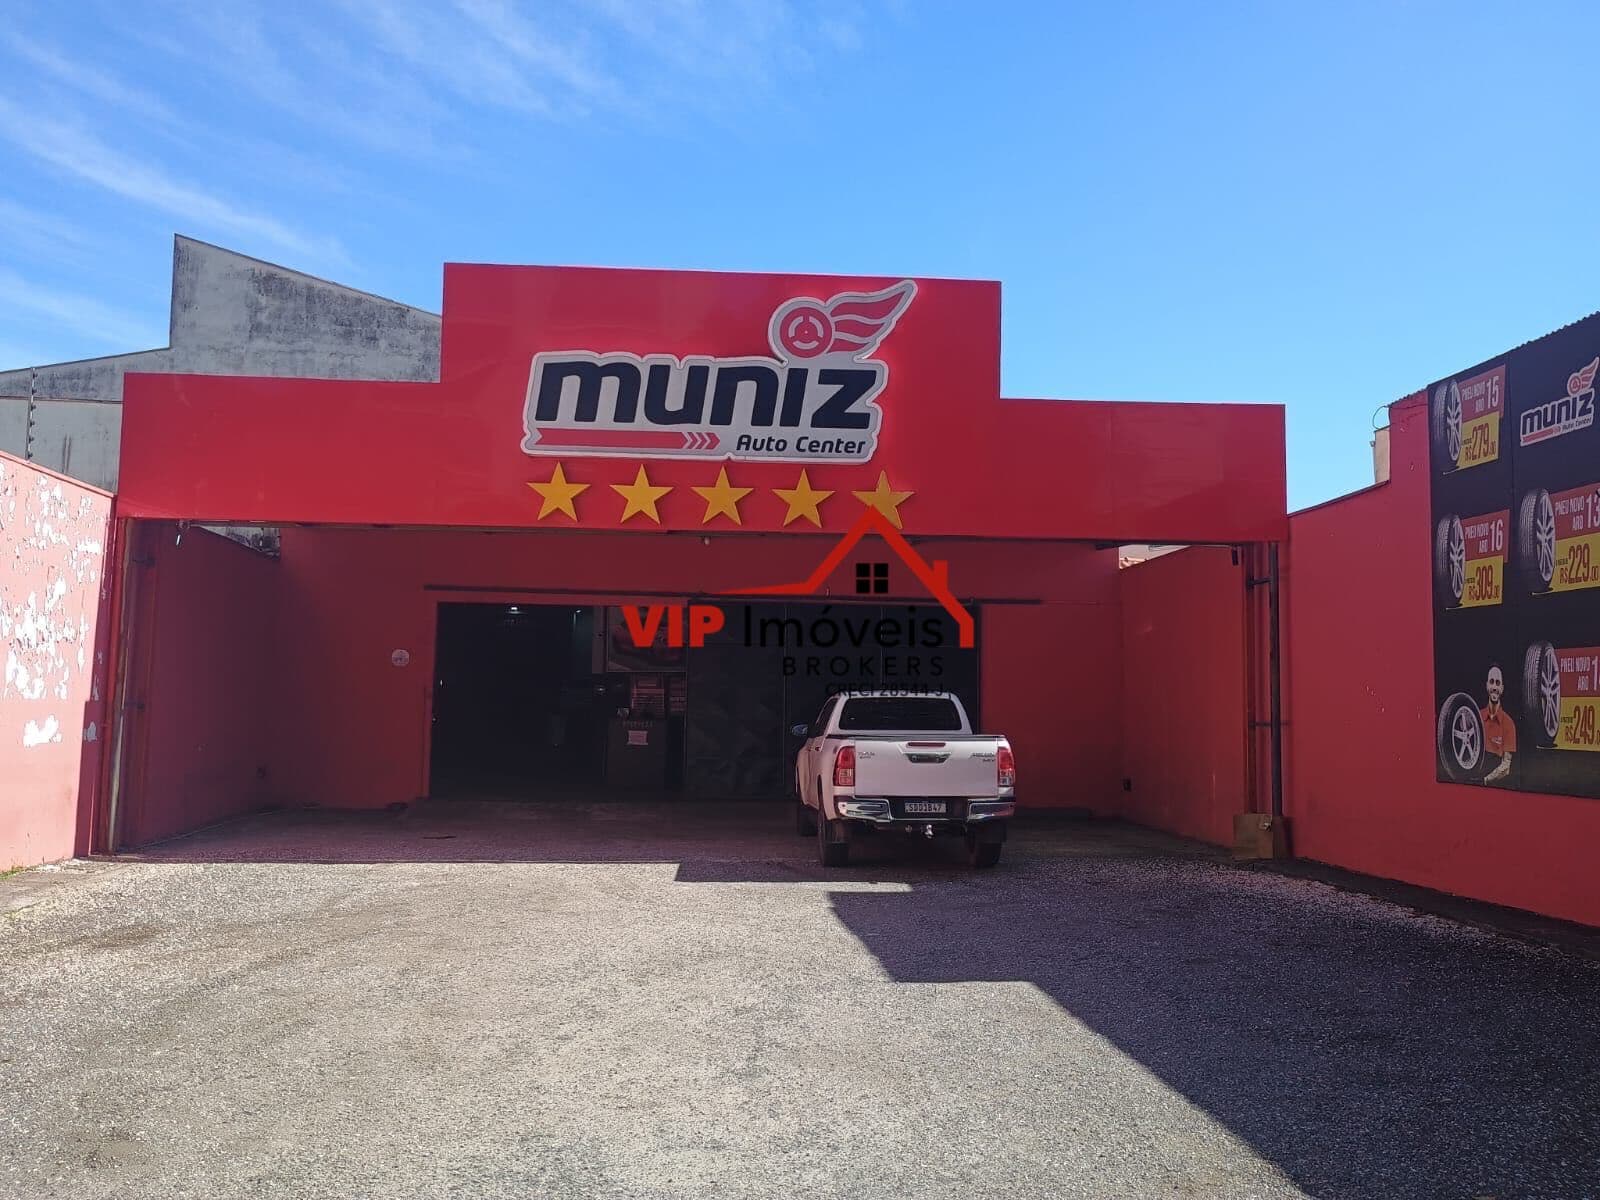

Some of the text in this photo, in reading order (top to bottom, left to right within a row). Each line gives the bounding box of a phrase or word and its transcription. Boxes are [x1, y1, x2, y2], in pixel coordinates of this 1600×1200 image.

[534, 361, 877, 429] muniz
[1486, 375, 1500, 409] 15
[1522, 391, 1593, 435] muniz
[736, 434, 866, 454] Auto Center
[1555, 495, 1584, 516] PNEU NOVO
[1464, 522, 1489, 540] PNEU NOVO
[1572, 515, 1584, 531] ARO
[1490, 518, 1504, 552] 16
[1478, 539, 1488, 554] ARO
[1560, 656, 1590, 673] PNEU NOVO
[1577, 675, 1589, 691] ARO
